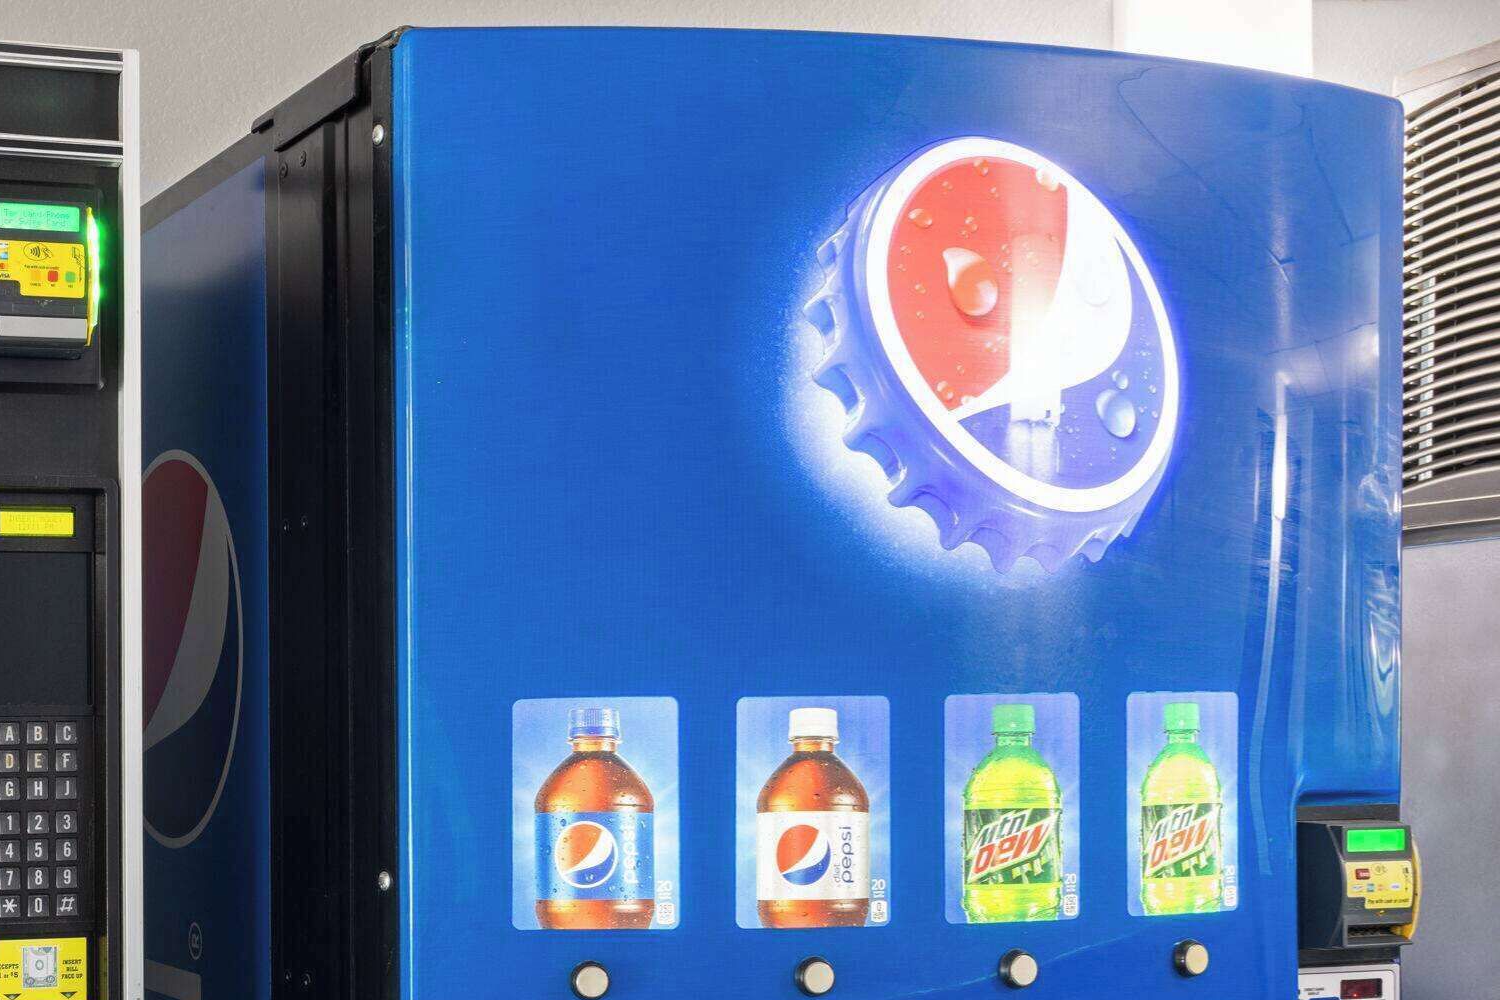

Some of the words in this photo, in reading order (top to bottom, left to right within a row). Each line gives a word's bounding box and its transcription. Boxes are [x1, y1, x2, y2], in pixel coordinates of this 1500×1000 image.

[6, 726, 14, 741] A
[33, 726, 43, 740] B
[62, 726, 71, 741] C
[5, 753, 14, 769] D
[34, 753, 42, 768] E
[62, 753, 70, 768] F
[5, 781, 14, 797] G
[34, 781, 43, 796] H
[64, 781, 70, 796] J
[6, 815, 12, 830] 1
[34, 815, 43, 830] 2
[63, 815, 71, 829] 3
[5, 843, 13, 858] 4
[34, 843, 42, 857] 5
[63, 842, 71, 857] 6
[622, 818, 638, 884] pepsi
[840, 826, 856, 885] pepsi
[6, 870, 13, 885] 7
[34, 870, 42, 885] 8
[63, 869, 71, 884] 9
[832, 862, 842, 885] diet
[871, 879, 886, 891] 20
[34, 898, 42, 913] 0
